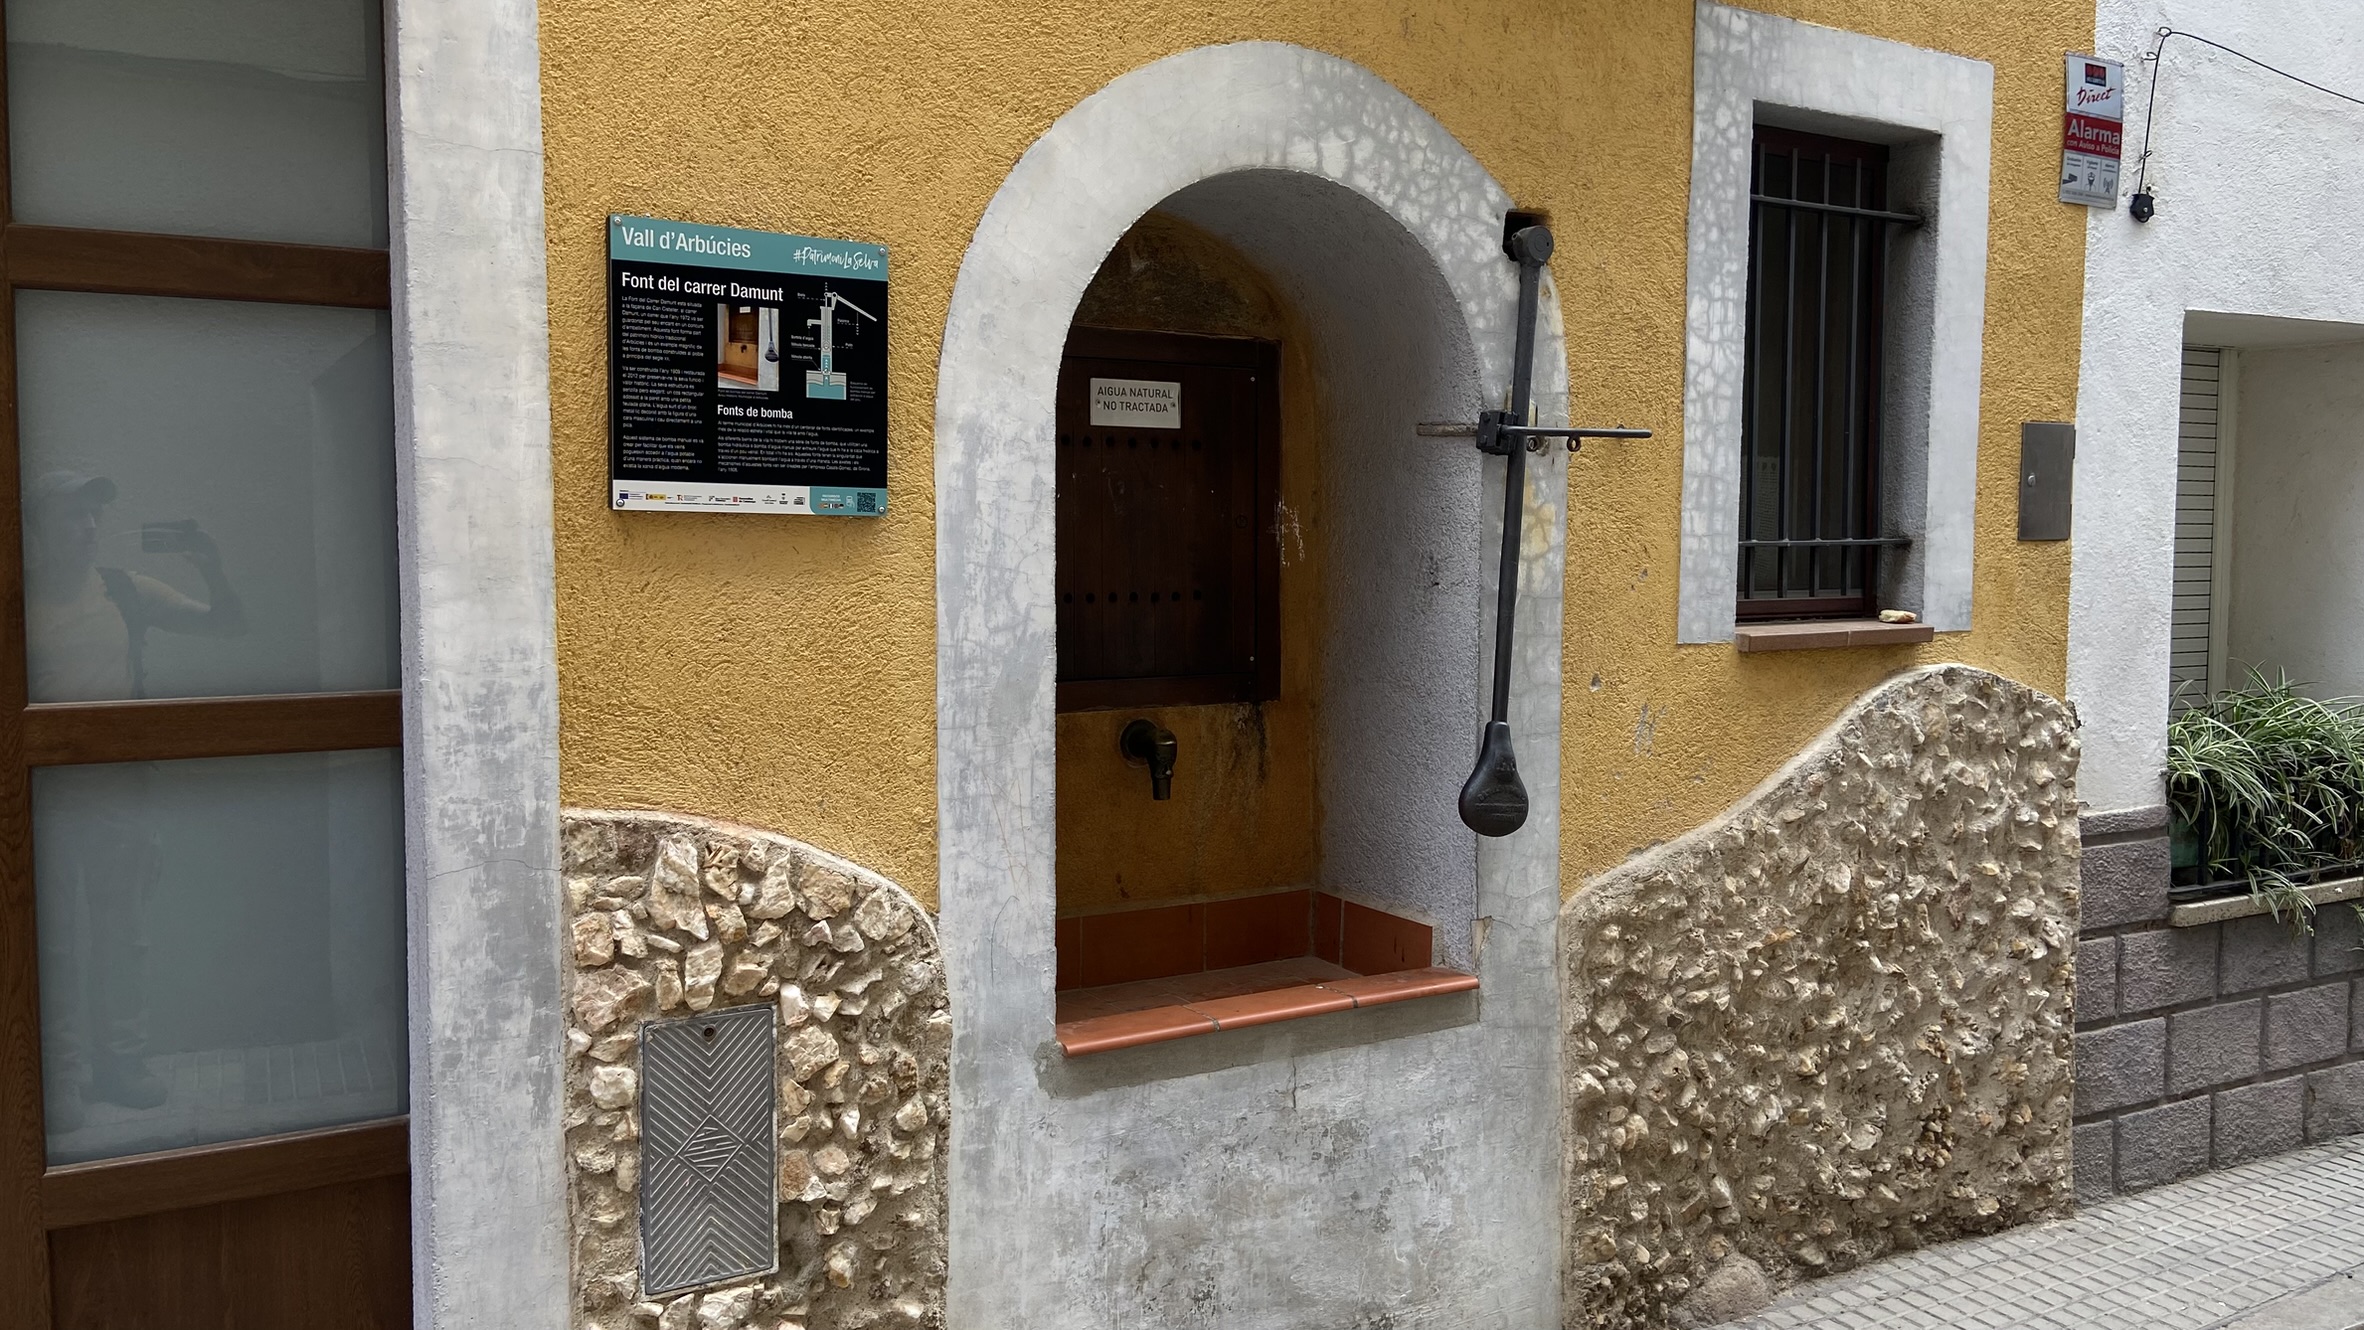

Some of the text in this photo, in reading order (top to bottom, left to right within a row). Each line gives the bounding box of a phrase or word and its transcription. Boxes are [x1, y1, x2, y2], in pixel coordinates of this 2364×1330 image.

[2077, 86, 2116, 106] Direct
[2068, 118, 2120, 145] Alarma
[2067, 140, 2078, 148] con
[2079, 140, 2095, 151] Aviso
[622, 226, 751, 258] Vall d'Arbúcies
[793, 246, 878, 270] #PatrimoniLaSelva
[622, 272, 784, 301] Font del carrer Damunt
[1097, 386, 1173, 399] AIGUA NATURAL
[718, 405, 793, 419] Fonts de bomba
[1103, 401, 1168, 413] NO TRACTADA
